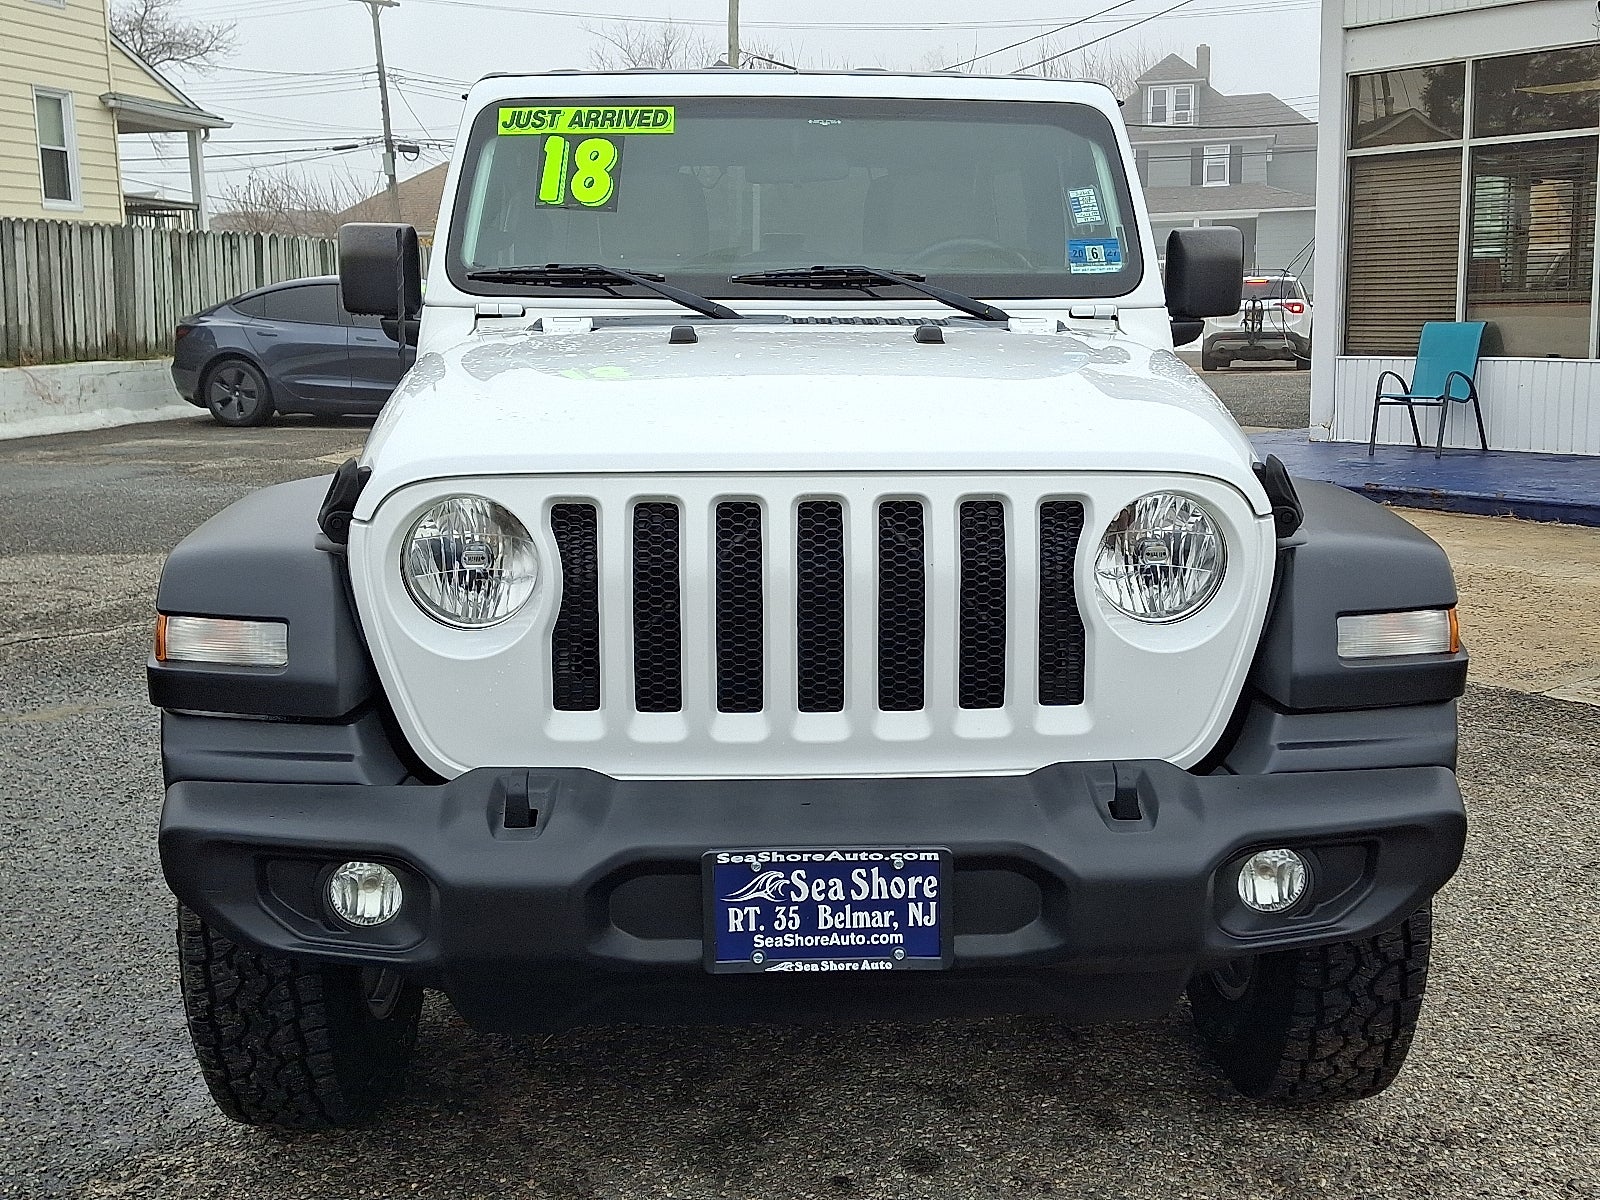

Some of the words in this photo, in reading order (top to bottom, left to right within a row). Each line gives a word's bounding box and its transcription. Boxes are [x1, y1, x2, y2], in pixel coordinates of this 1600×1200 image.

[502, 110, 564, 130] JUST
[568, 109, 672, 129] ARRIVED
[538, 135, 618, 207] 18
[1072, 249, 1084, 258] 20
[1091, 247, 1099, 260] 6
[716, 851, 940, 864] SeaShoreAuto.com
[790, 869, 846, 902] Sea
[851, 867, 938, 901] Shore
[728, 906, 765, 932] RT.
[773, 906, 801, 931] 35
[817, 904, 899, 931] Belmar,
[907, 902, 938, 927] NJ
[753, 933, 904, 948] SeaShoreAuto.com
[794, 961, 819, 972] Sea
[820, 960, 859, 971] Shore
[861, 960, 893, 970] Auto
